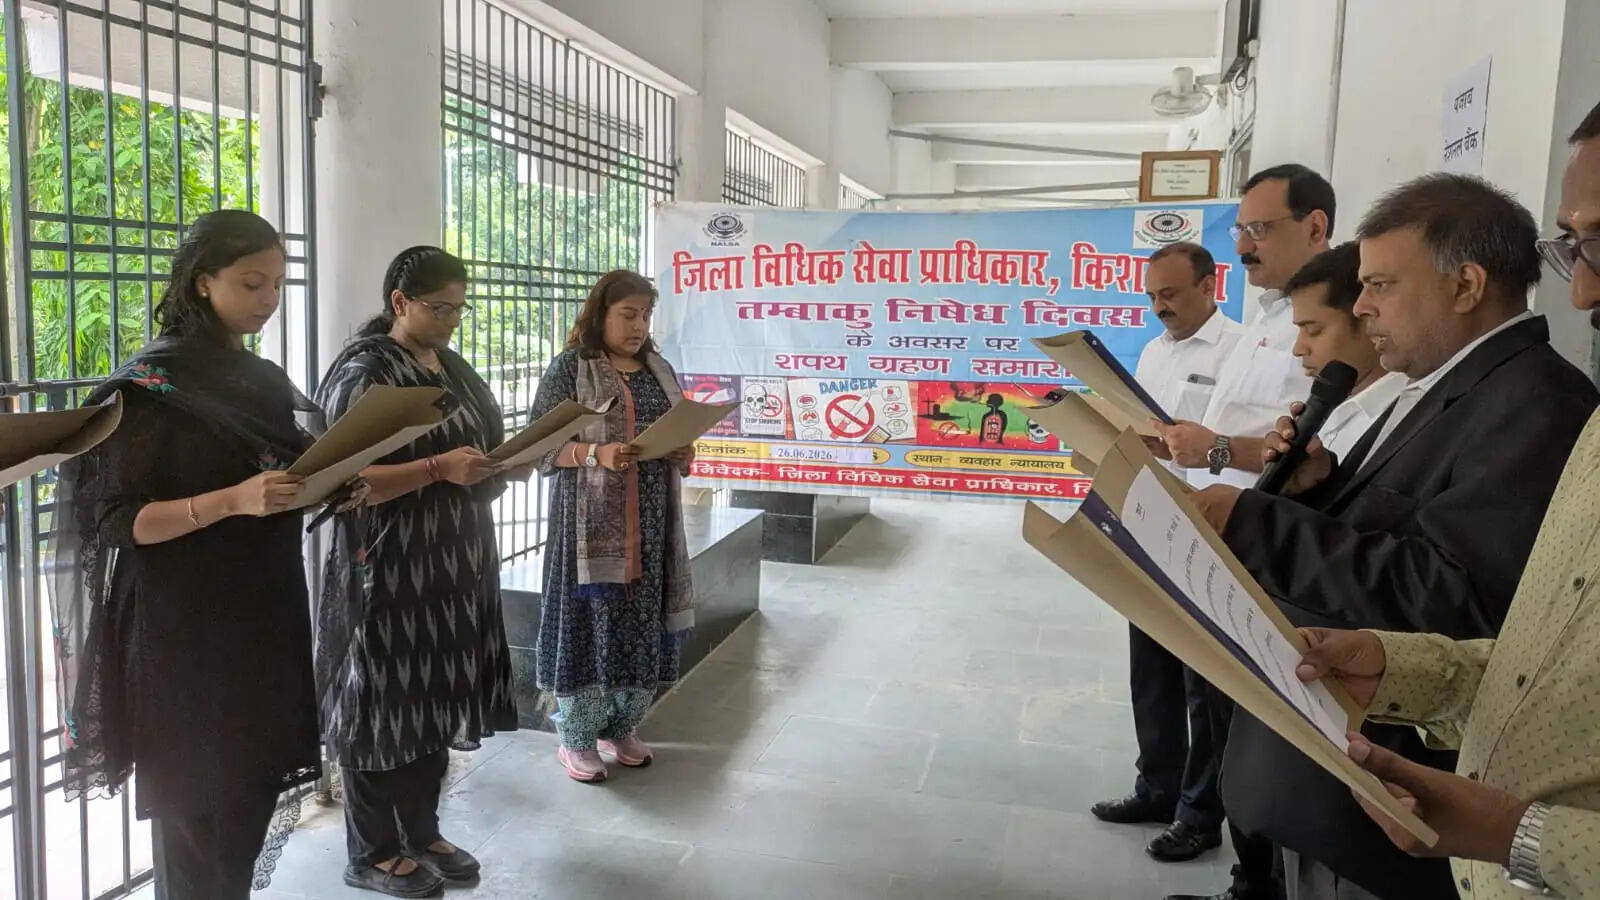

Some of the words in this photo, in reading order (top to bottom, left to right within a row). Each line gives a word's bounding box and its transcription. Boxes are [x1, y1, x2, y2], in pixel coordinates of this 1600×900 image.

[672, 250, 746, 294] जिला
[752, 242, 846, 288] विधिक
[853, 240, 913, 284] सेवा
[919, 239, 1060, 294] प्राधिकार,
[735, 301, 873, 330] तम्बाकु
[884, 299, 1010, 325] निषेध
[1021, 300, 1148, 328] दिवस
[846, 330, 874, 348] के
[888, 335, 968, 350] अवसर
[984, 336, 1020, 352] पर
[775, 353, 847, 371] शपथ
[868, 355, 950, 375] ग्रहण
[819, 378, 878, 394] DANGER
[778, 448, 833, 460] 26.06.2026
[959, 456, 1002, 467] व्यवहार
[1010, 458, 1065, 470] न्यायालय
[778, 467, 829, 481] जिला
[836, 470, 905, 484] विधिक
[912, 472, 957, 487] सेवा
[965, 476, 1064, 494] प्राधिकार,
